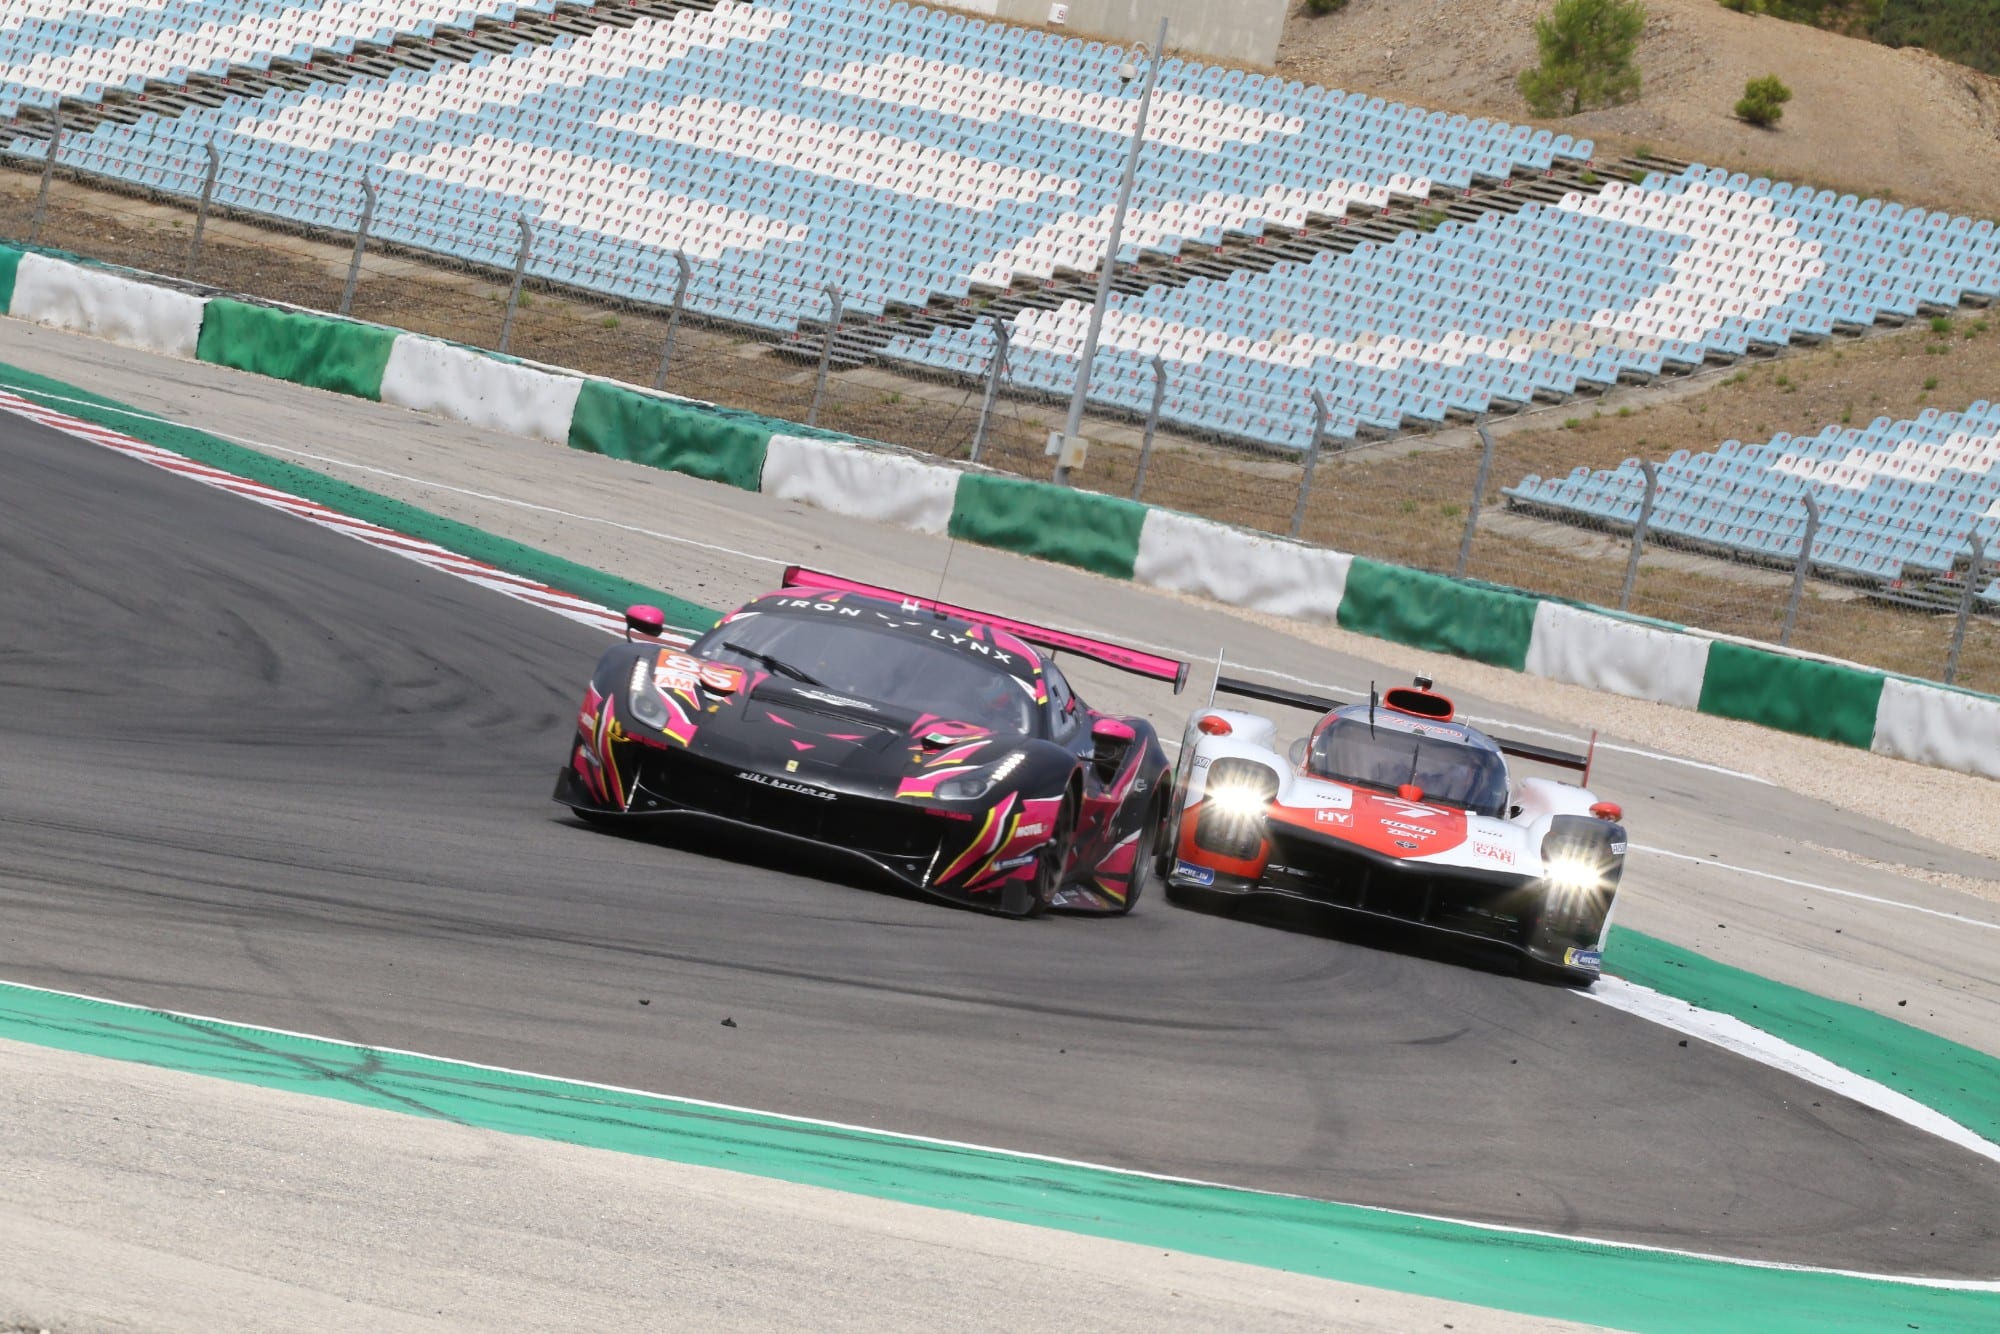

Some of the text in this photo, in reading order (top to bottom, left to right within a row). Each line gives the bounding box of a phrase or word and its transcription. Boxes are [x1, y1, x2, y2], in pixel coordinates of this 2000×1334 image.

[776, 598, 861, 618] IRON
[930, 629, 1012, 665] LYNX
[665, 654, 733, 690] 85
[659, 675, 692, 690] AM
[1371, 795, 1450, 818] 7
[1317, 810, 1350, 823] HY
[1386, 827, 1428, 841] ZENT
[1476, 847, 1511, 862] CAR
